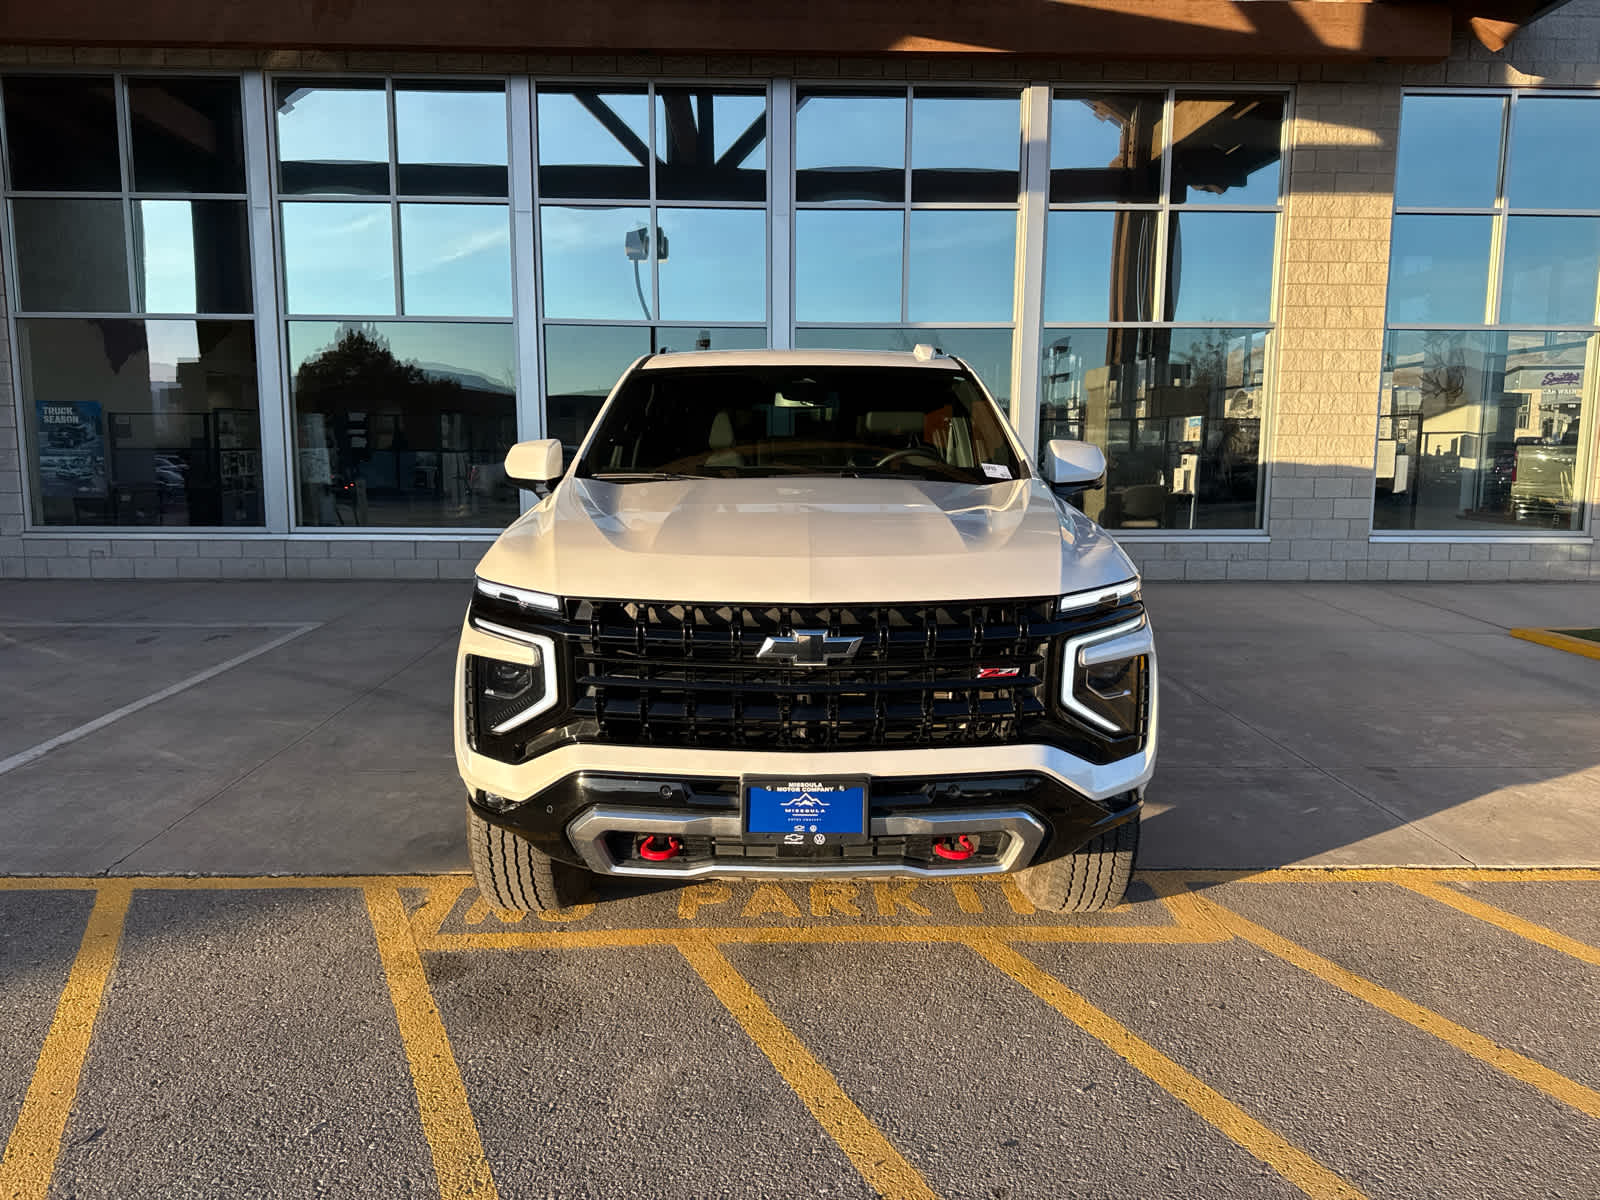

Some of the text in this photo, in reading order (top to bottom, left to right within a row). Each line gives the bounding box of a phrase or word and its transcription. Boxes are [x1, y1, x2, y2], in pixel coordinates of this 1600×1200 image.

[43, 406, 73, 415] TRUCK
[43, 415, 79, 424] SEASON
[677, 880, 1131, 920] PARKI
